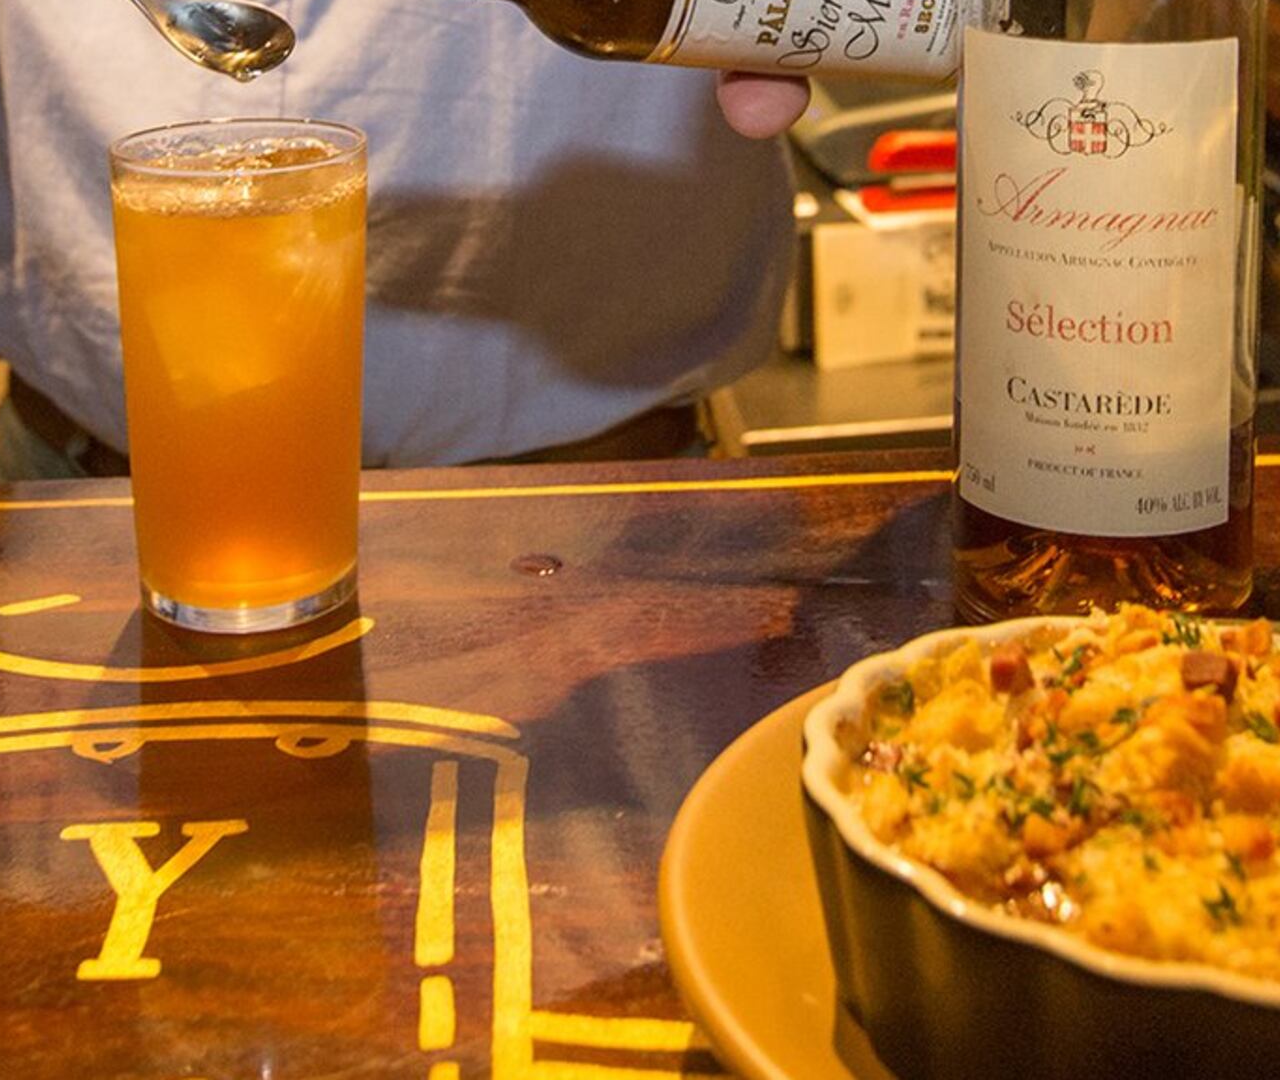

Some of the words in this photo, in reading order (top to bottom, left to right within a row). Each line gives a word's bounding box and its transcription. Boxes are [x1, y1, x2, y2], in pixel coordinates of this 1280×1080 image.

[977, 166, 1218, 253] Armagnac
[1005, 299, 1174, 346] Sélection
[1006, 375, 1172, 416] CASTARÈDE
